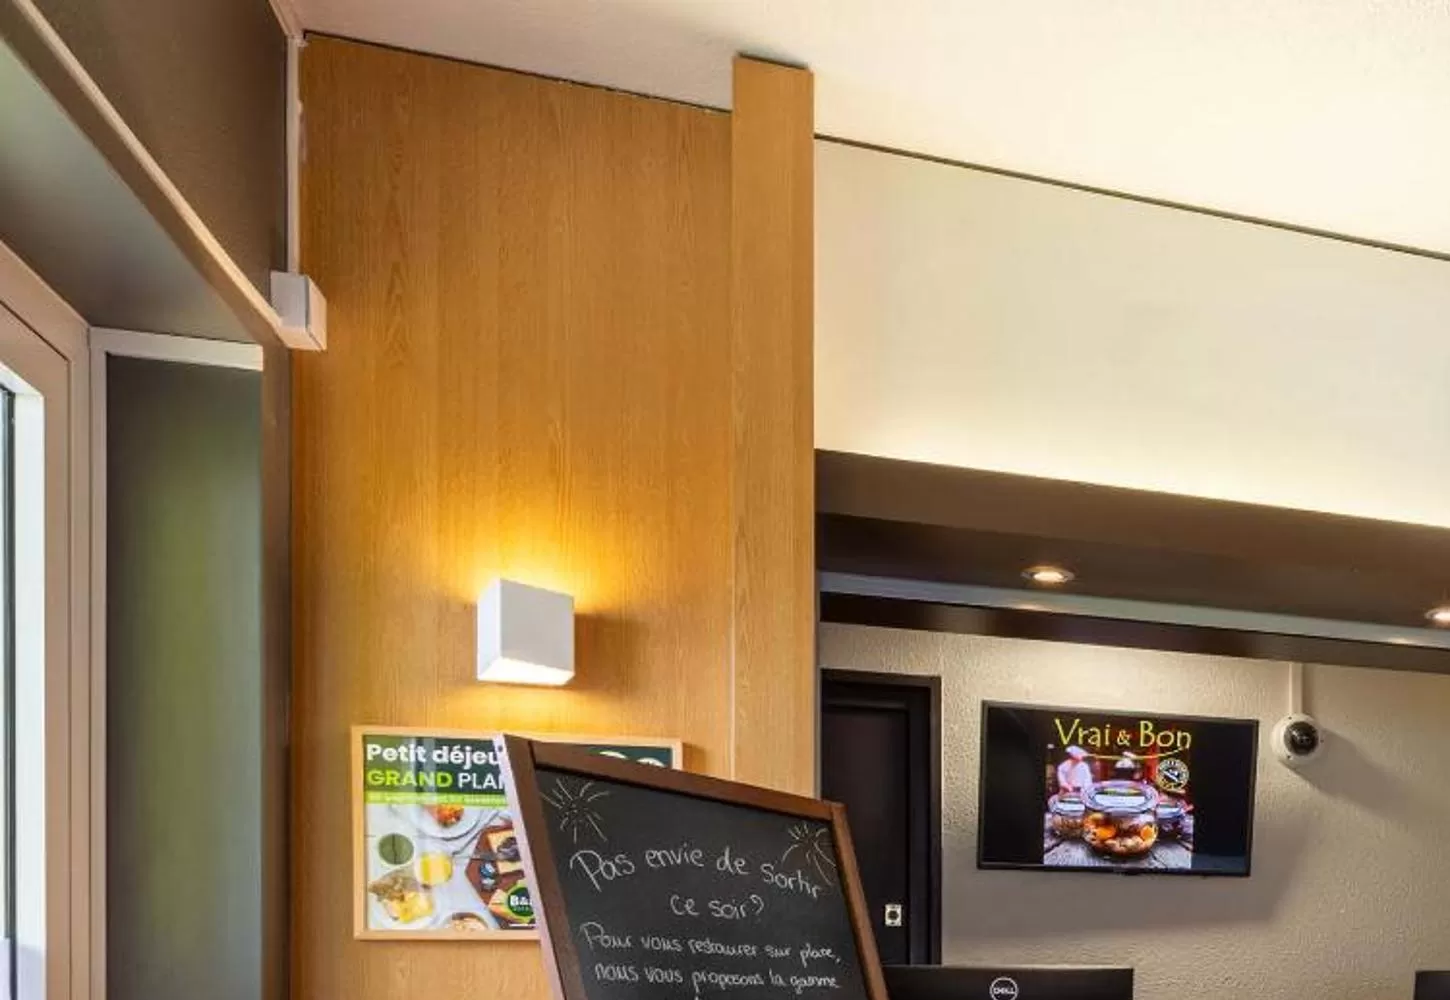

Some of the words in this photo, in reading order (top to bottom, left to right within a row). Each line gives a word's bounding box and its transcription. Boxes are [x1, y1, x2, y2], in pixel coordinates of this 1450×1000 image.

[1054, 718, 1111, 747] Vrai
[1116, 729, 1131, 746] &
[1139, 720, 1192, 749] Bon
[366, 744, 427, 763] Petit
[366, 770, 453, 788] GRAND
[570, 850, 636, 892] Pas
[645, 842, 705, 868] envie
[716, 846, 750, 875] de
[578, 921, 632, 951] Pour
[641, 935, 683, 952] vous
[644, 966, 684, 983] vous
[790, 974, 842, 995] gamme
